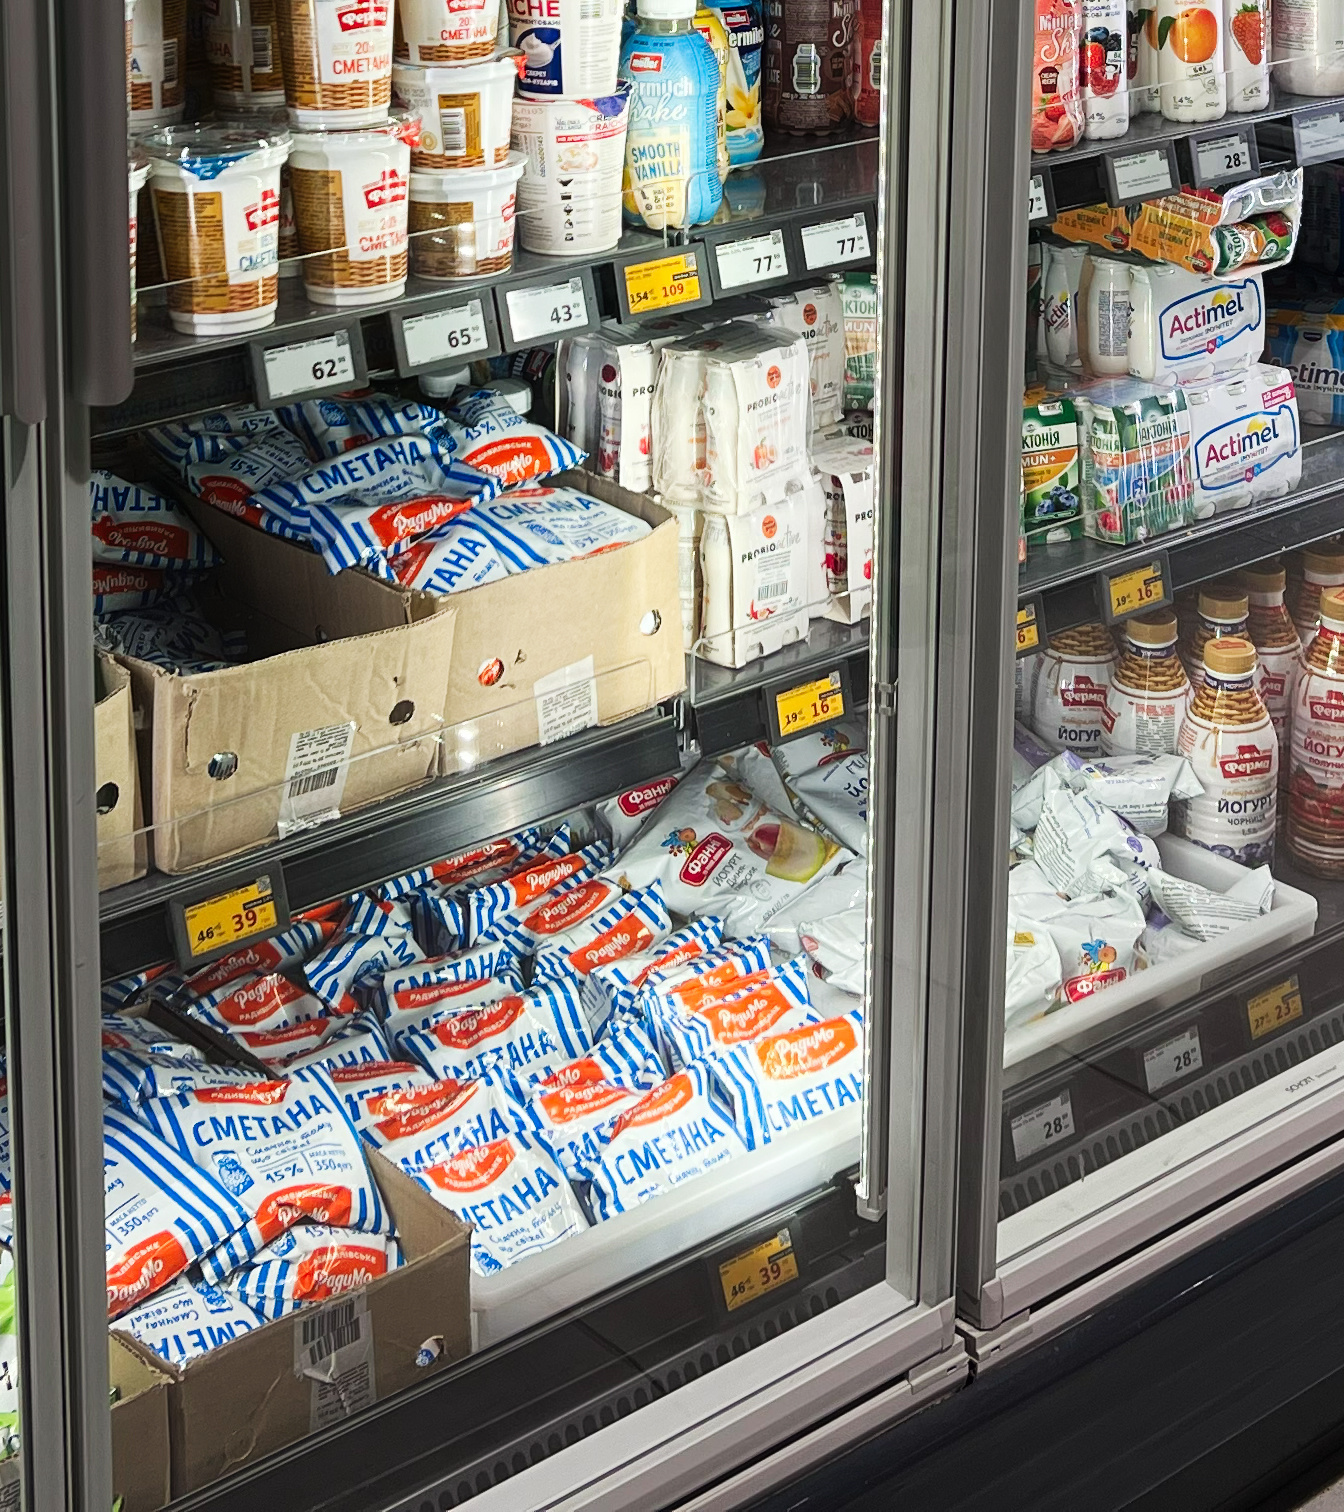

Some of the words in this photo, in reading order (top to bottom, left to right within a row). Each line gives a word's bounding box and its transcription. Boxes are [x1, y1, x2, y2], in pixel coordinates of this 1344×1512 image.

[342, 7, 388, 28] Ферма
[333, 56, 390, 76] СМЕТАНА
[631, 142, 681, 162] SMOOTH
[837, 237, 856, 256] 77
[754, 255, 774, 274] 77
[662, 281, 684, 299] 109
[550, 305, 573, 324] 43
[1169, 298, 1245, 338] Actimel
[447, 329, 471, 348] 65
[311, 359, 337, 380] 62
[1205, 422, 1281, 470] Actimel
[303, 441, 424, 496] СМЕТАНА
[1137, 584, 1153, 600] 16
[810, 699, 830, 717] 16
[1224, 756, 1271, 777] Ферма
[1217, 794, 1278, 815] ЙОГУРТ
[232, 908, 257, 933] 39
[1275, 999, 1292, 1019] 23
[1174, 1048, 1192, 1071] 28
[193, 1092, 333, 1146] СМЕТАНА
[614, 1117, 720, 1185] СМЕТАНА
[759, 1260, 782, 1286] 39
